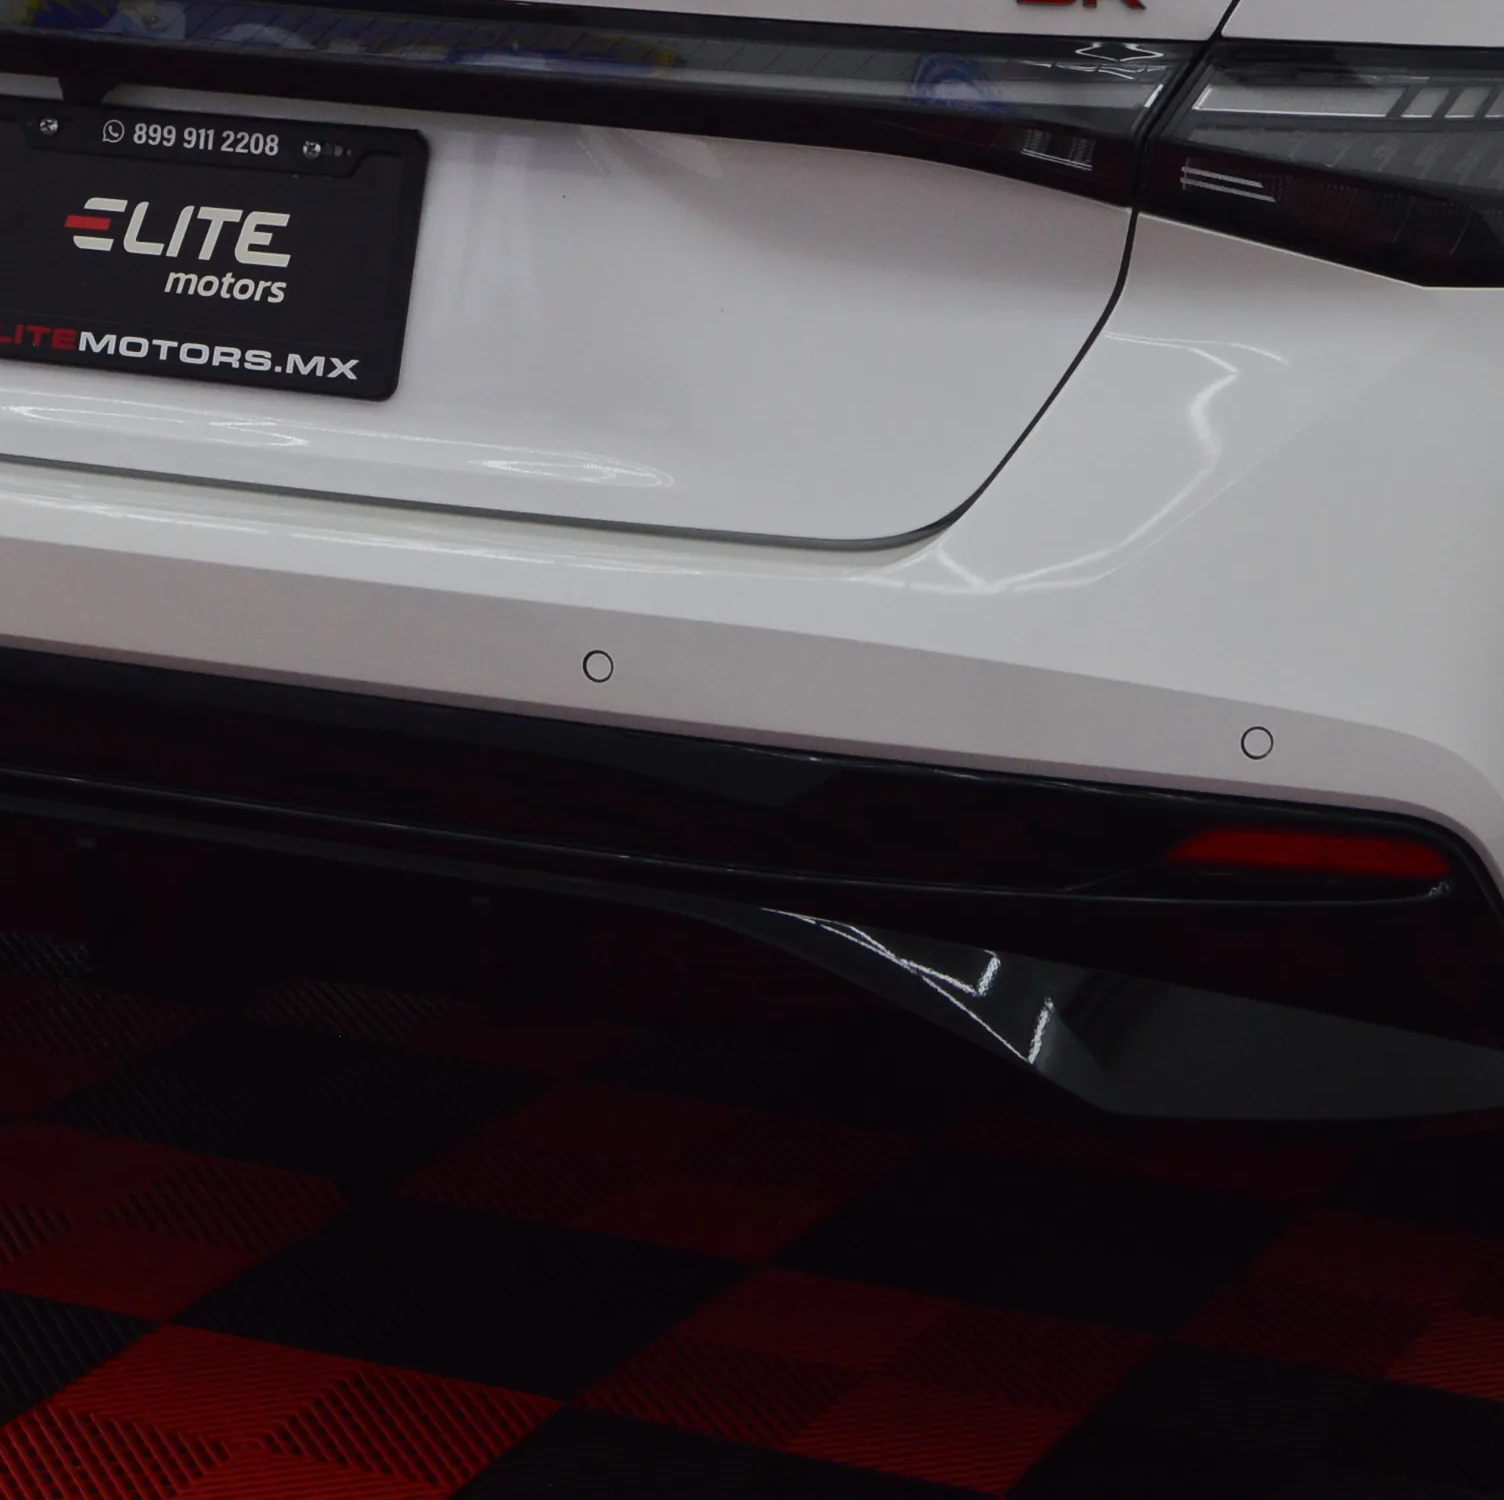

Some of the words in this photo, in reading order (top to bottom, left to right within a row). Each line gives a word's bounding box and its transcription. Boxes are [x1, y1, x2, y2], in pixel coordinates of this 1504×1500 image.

[132, 123, 177, 148] 899
[182, 127, 216, 151] 911
[221, 130, 280, 156] 2208
[64, 197, 291, 268] ELITE
[164, 272, 287, 304] motors
